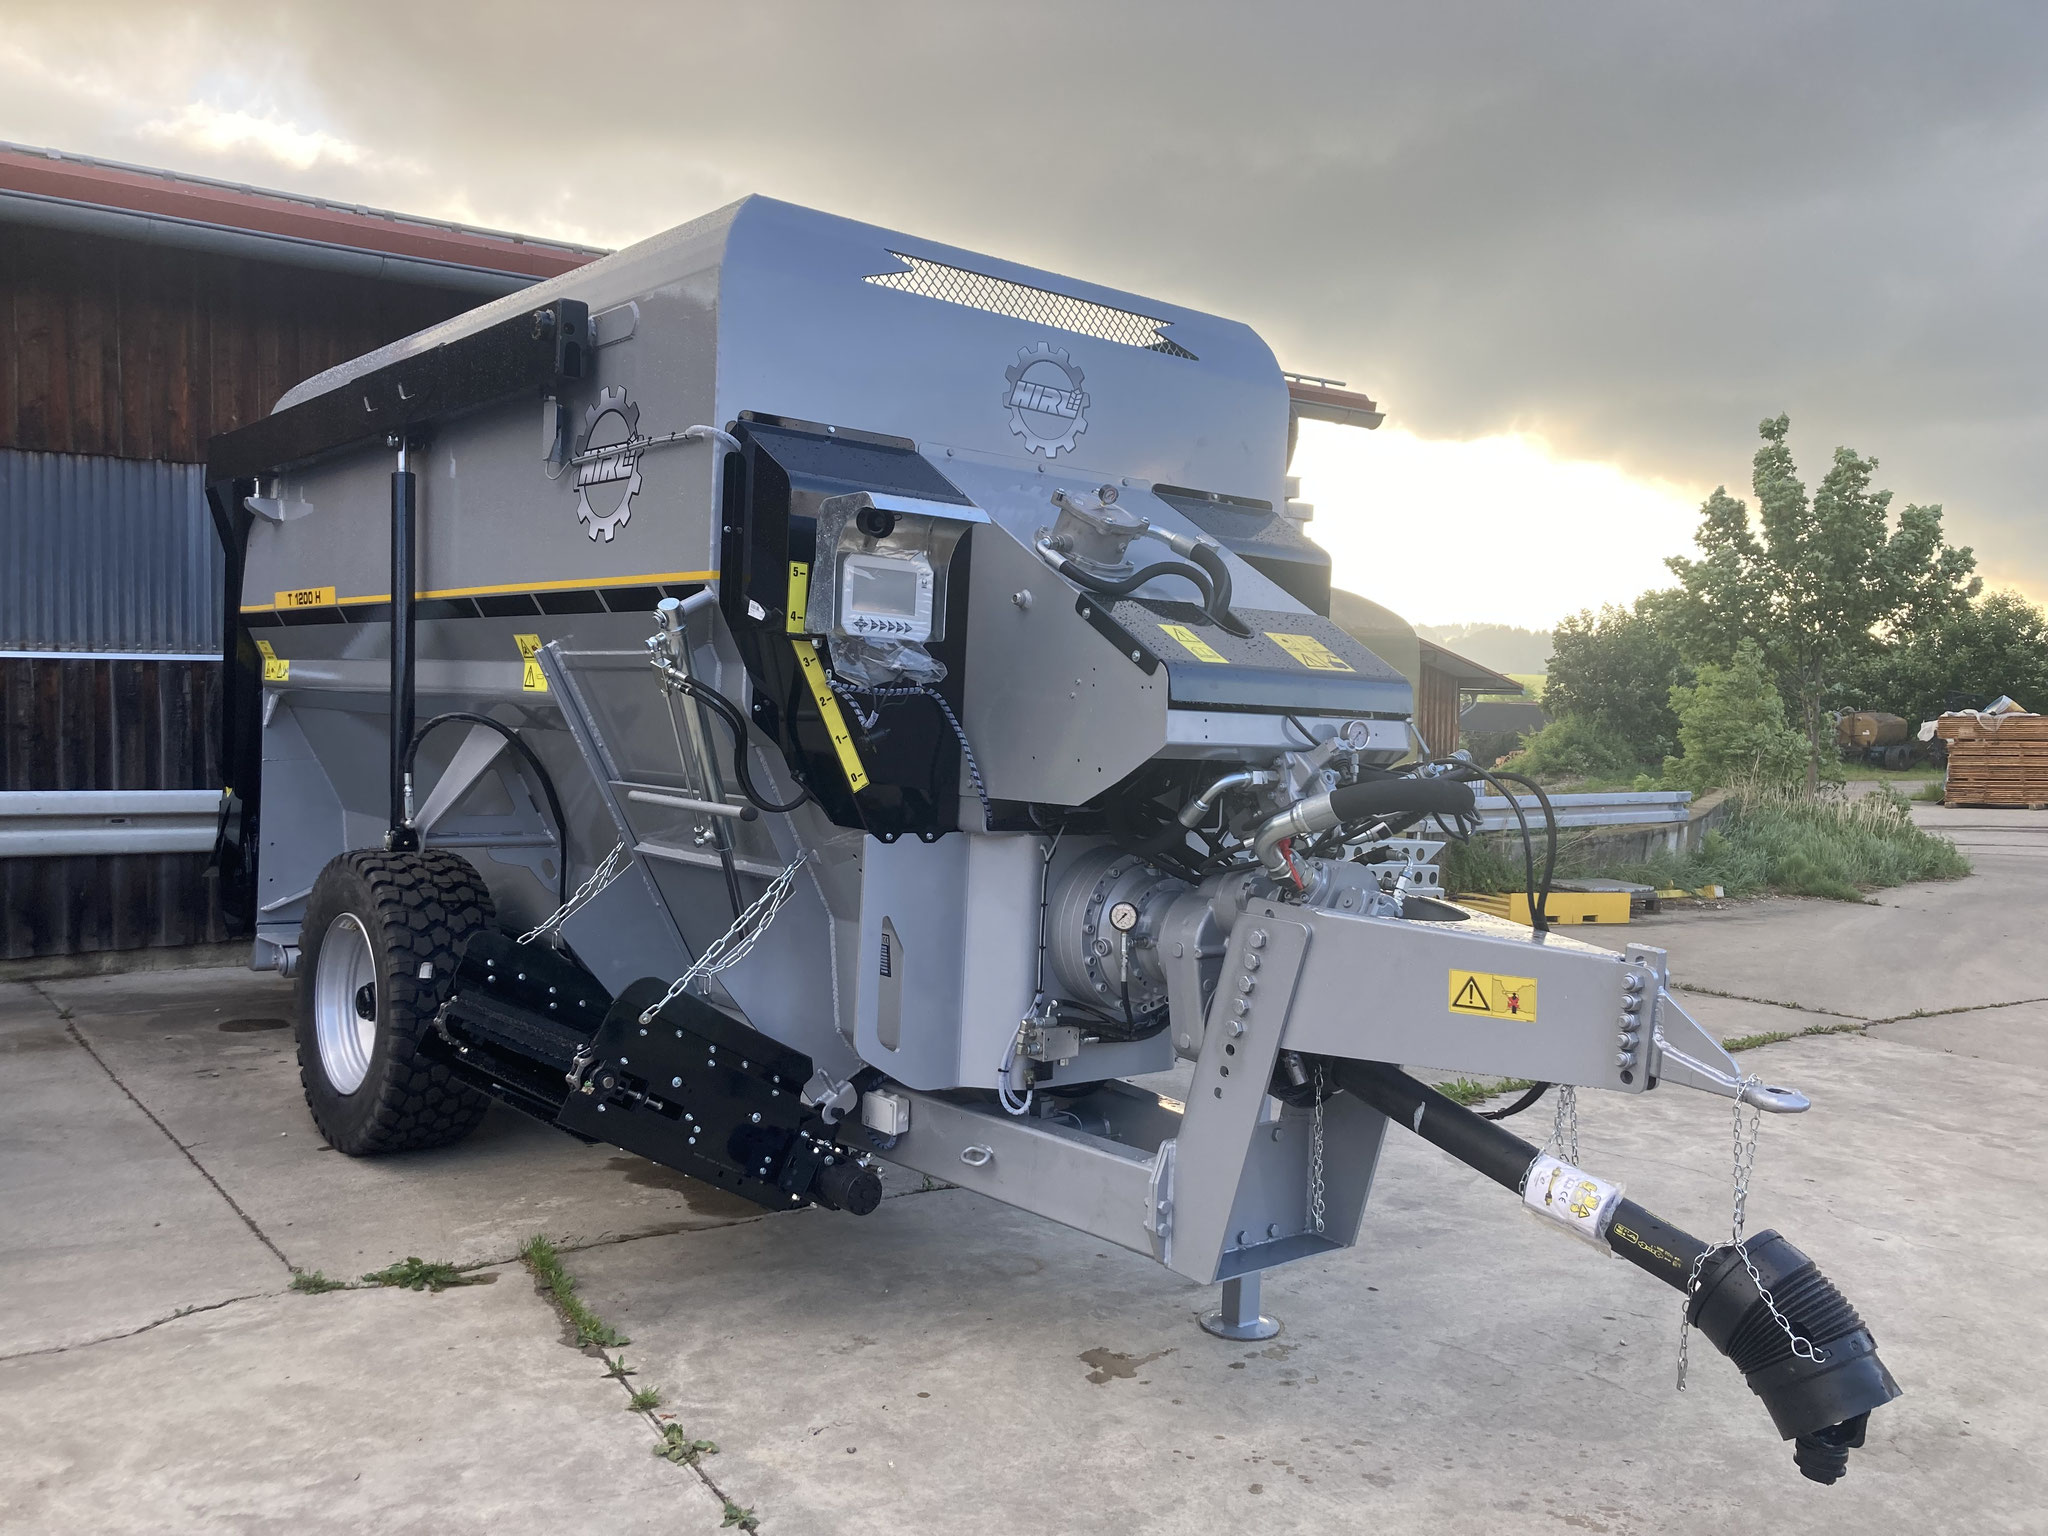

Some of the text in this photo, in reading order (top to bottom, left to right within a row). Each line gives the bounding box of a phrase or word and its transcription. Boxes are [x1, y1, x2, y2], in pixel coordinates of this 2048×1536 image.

[793, 567, 799, 577] 5
[288, 590, 321, 606] T 1200 H
[790, 611, 797, 621] 4
[803, 657, 810, 667] 3
[819, 696, 827, 706] 2
[835, 735, 842, 745] 1
[850, 773, 858, 783] 0
